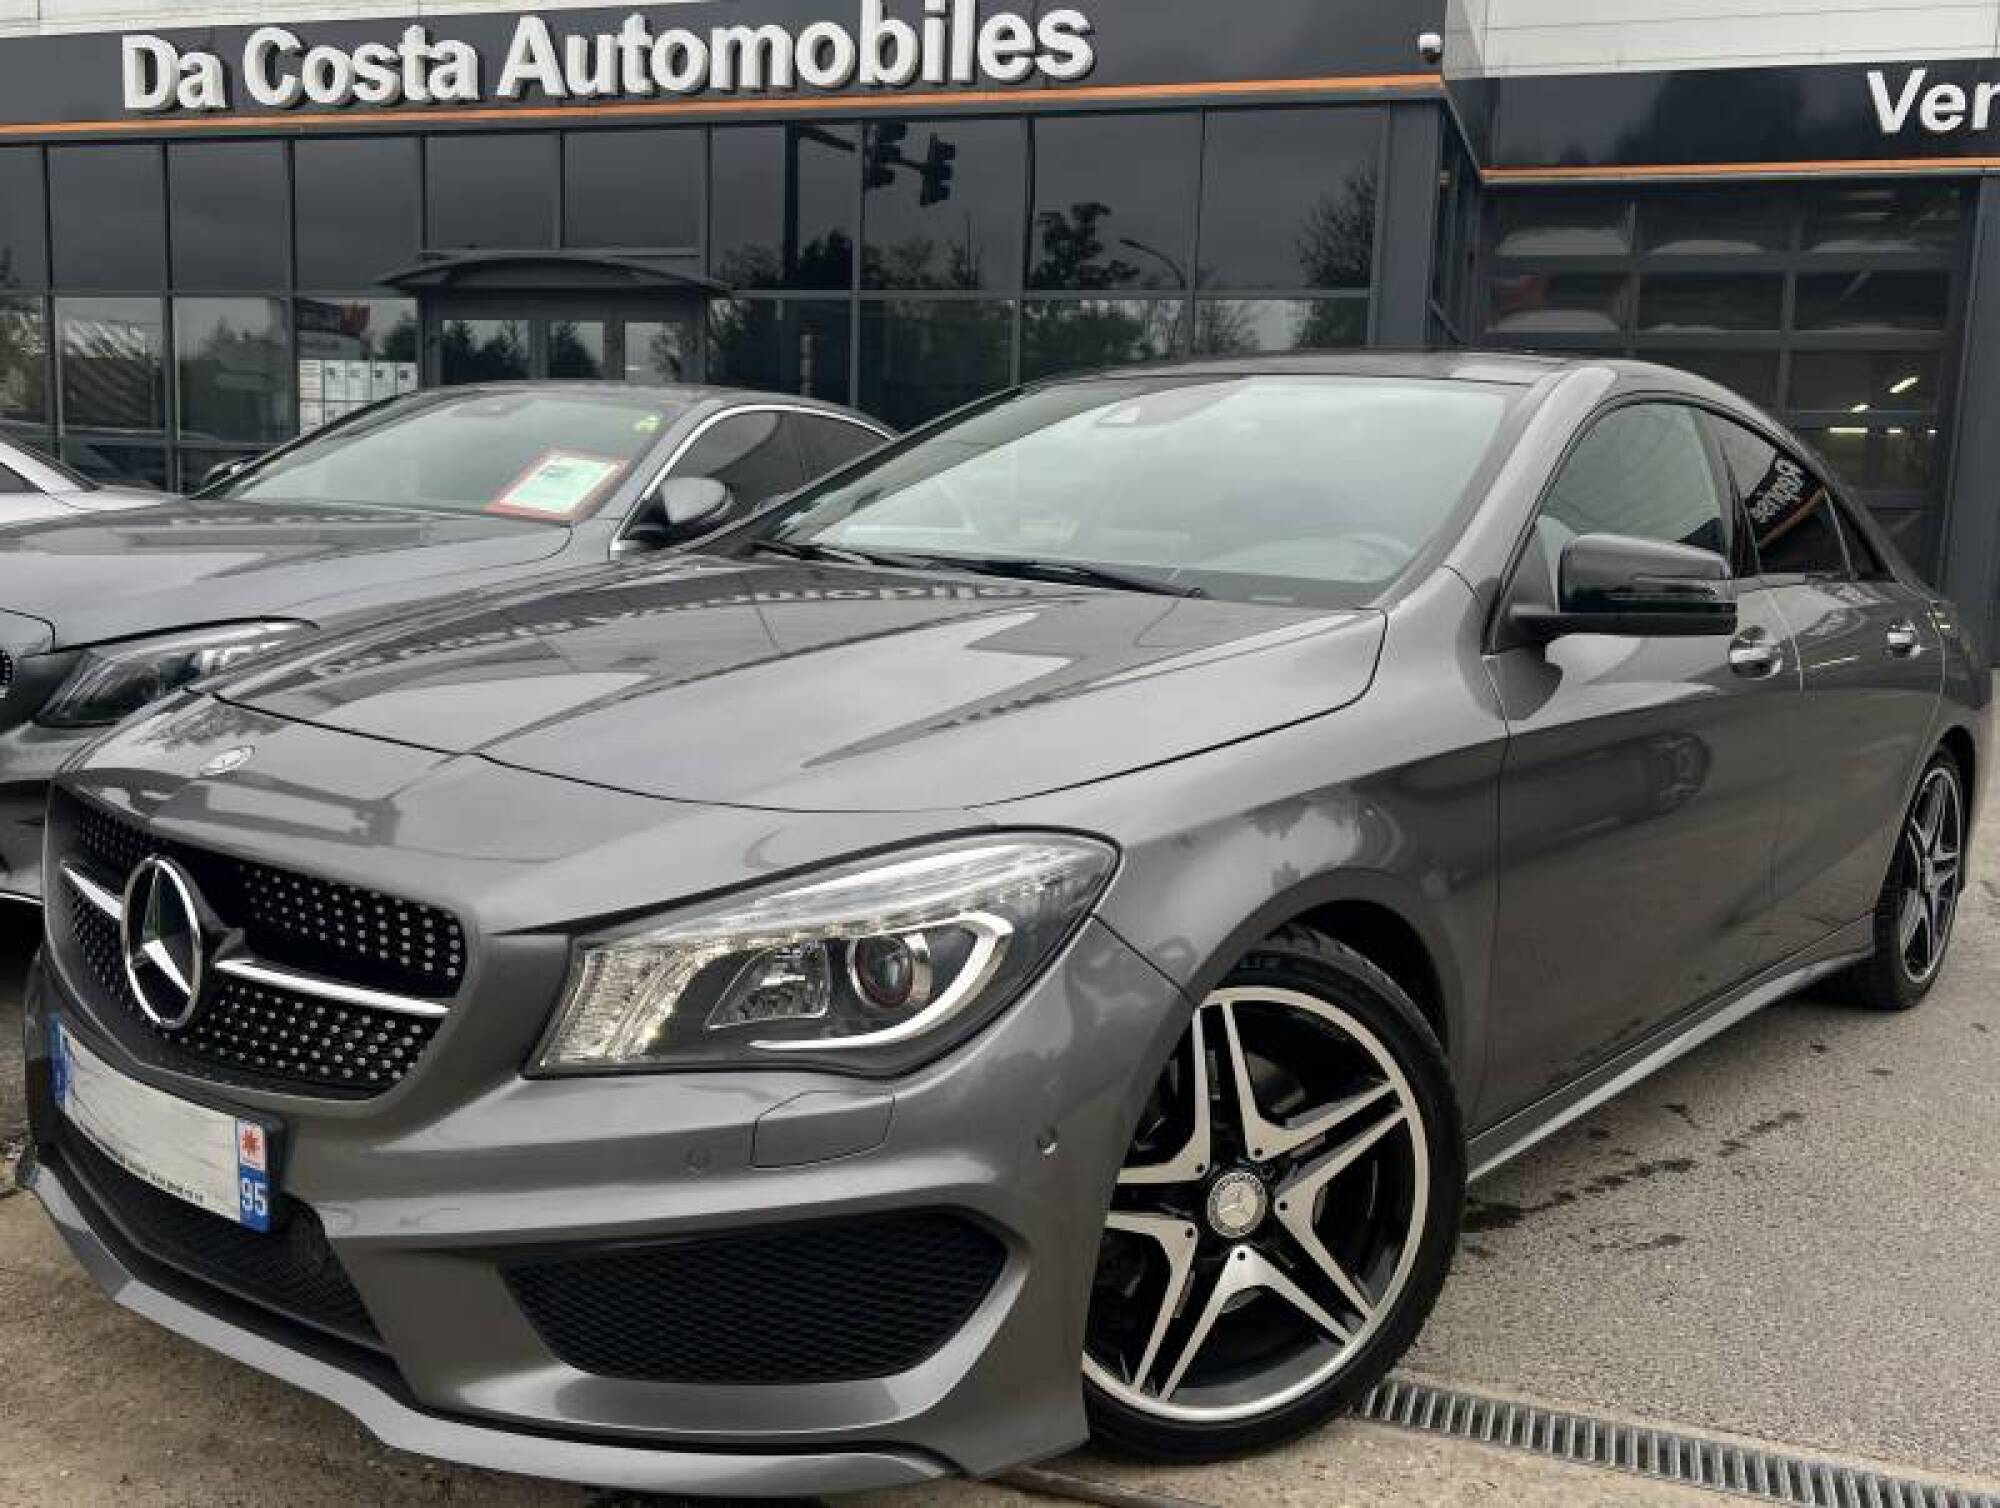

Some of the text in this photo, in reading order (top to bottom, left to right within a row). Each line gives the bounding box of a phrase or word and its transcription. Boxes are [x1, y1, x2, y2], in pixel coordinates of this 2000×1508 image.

[122, 0, 1096, 110] Da Costa Automobiles
[240, 1177, 267, 1217] 95
